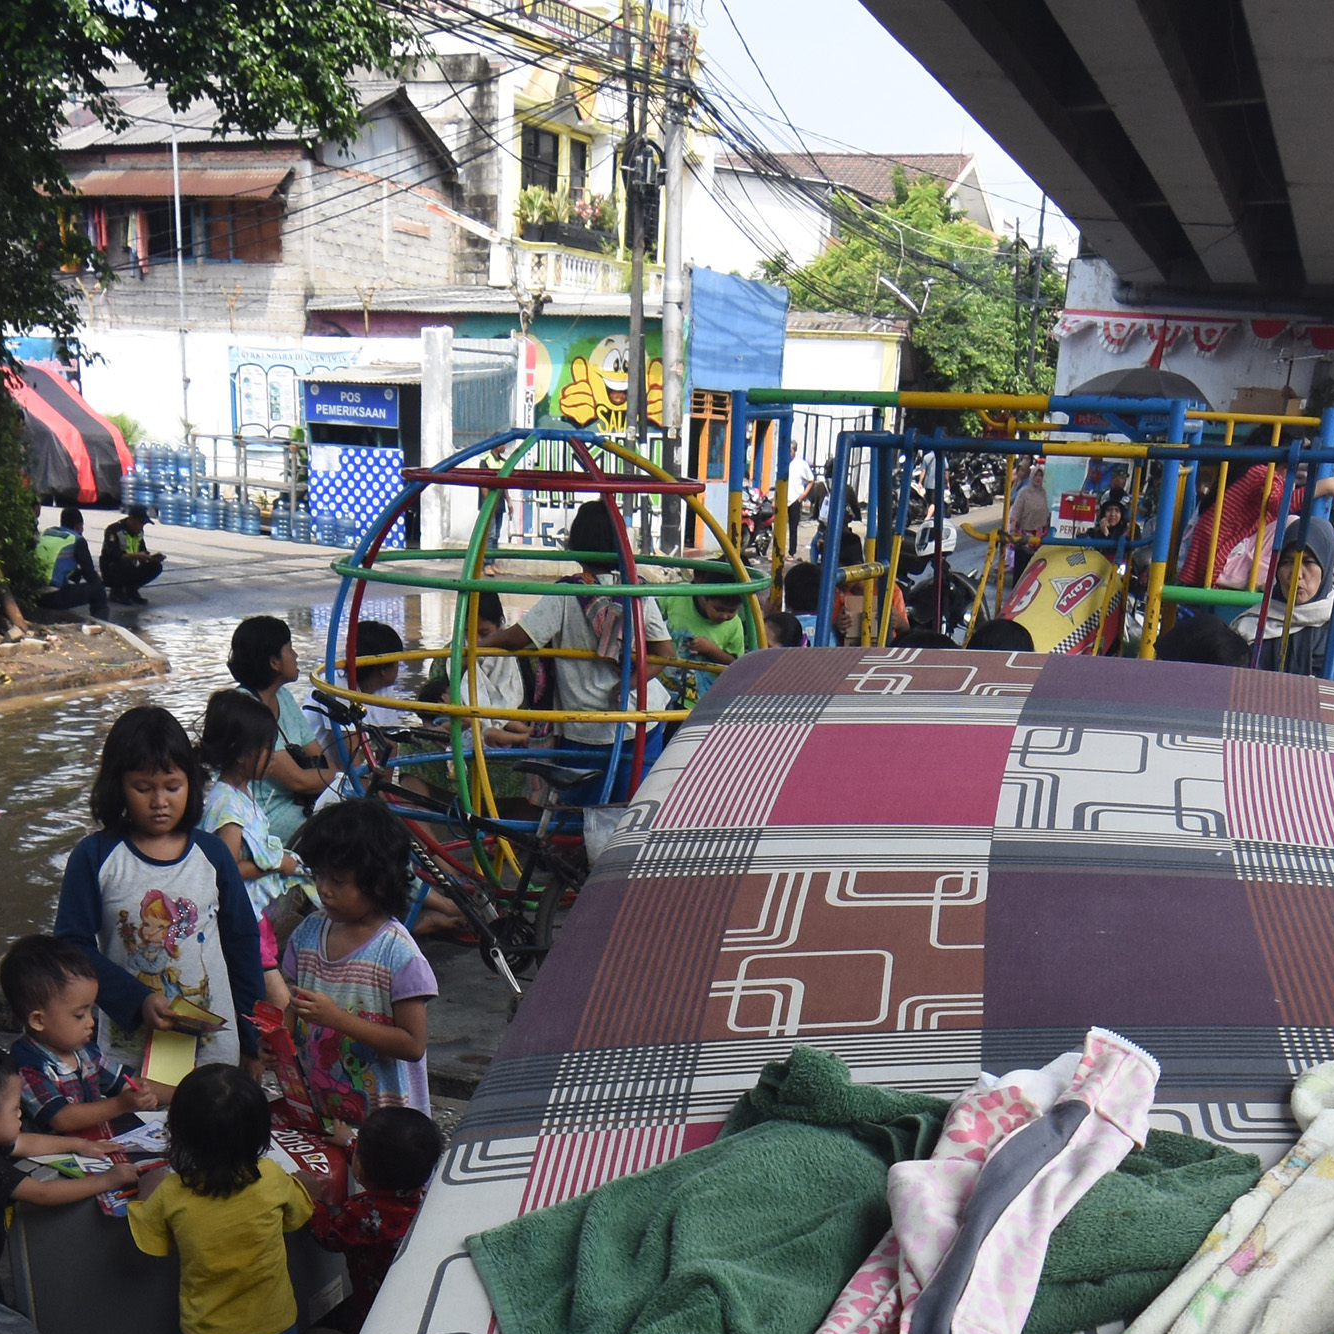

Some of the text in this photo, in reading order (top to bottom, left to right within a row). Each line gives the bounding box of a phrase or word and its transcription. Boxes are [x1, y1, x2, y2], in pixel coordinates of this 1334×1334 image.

[340, 391, 361, 403] POS
[316, 404, 387, 419] PEMERIKSAAN
[270, 1128, 315, 1153] 2019
